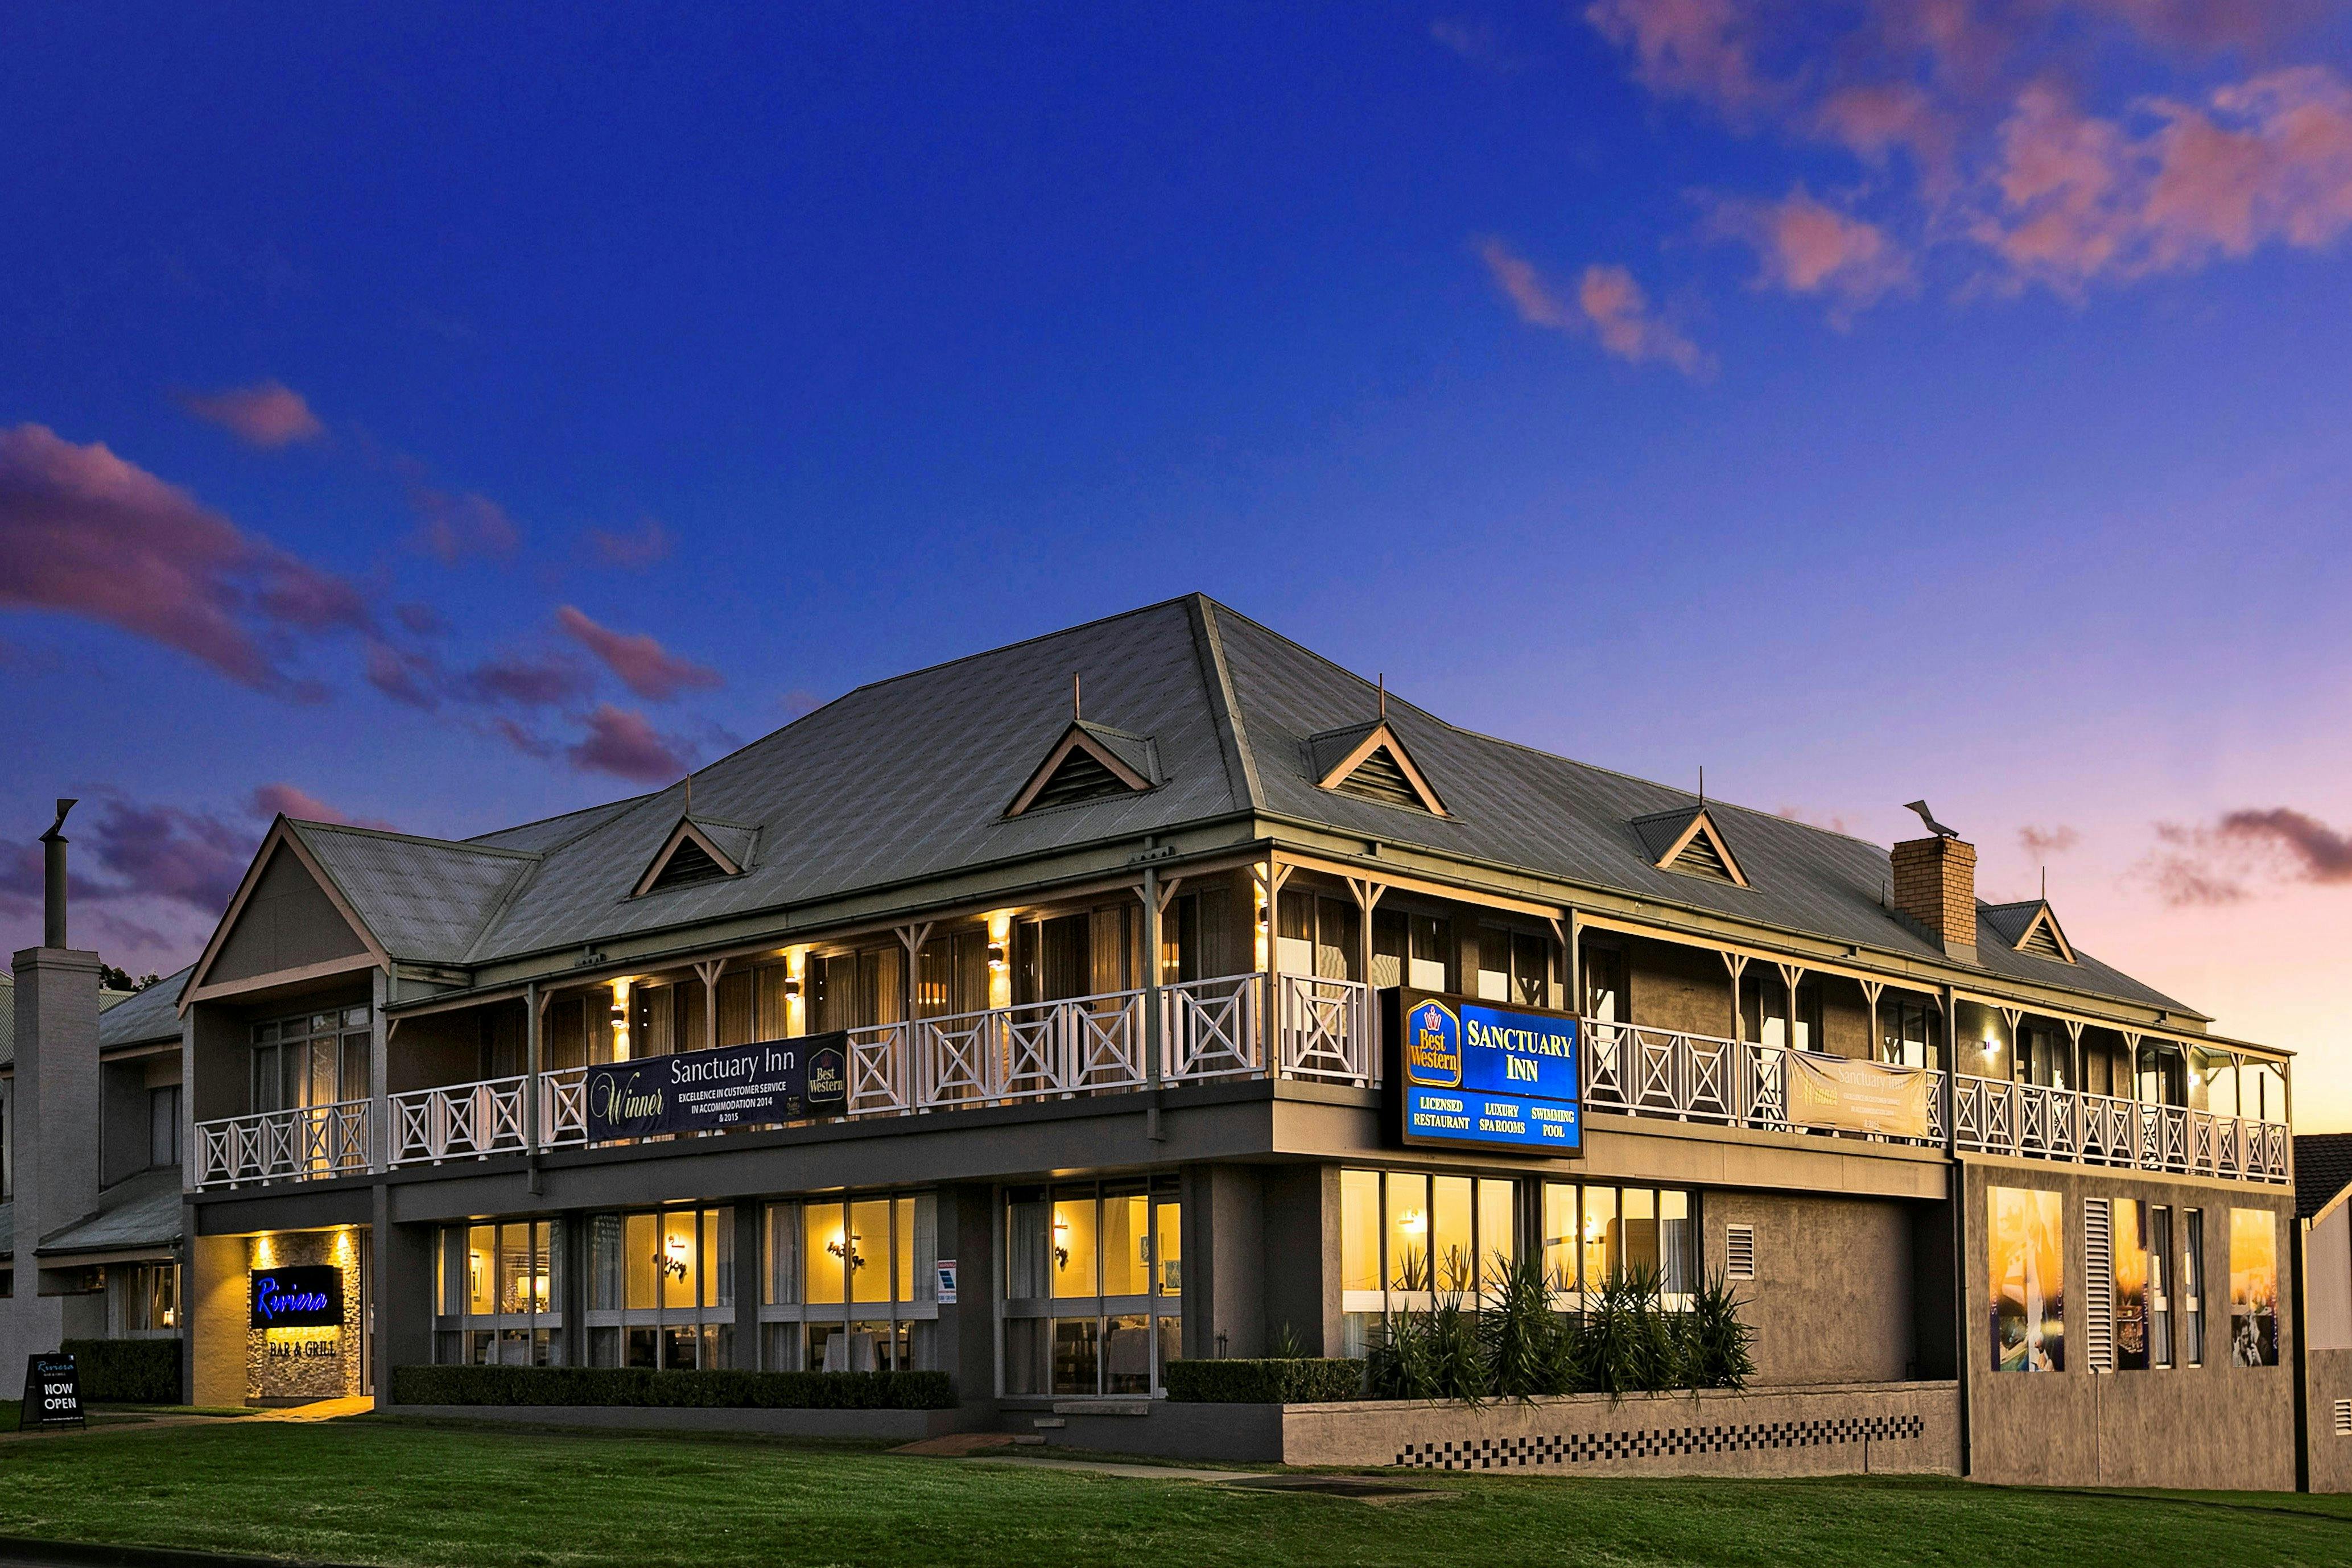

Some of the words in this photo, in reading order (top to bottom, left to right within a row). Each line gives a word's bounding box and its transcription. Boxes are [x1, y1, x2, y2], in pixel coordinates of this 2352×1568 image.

[1419, 1028, 1446, 1051] Best
[1468, 1020, 1573, 1058] SANCTUARY
[671, 1055, 758, 1084] Sanctuary
[765, 1048, 795, 1072] Inn
[1410, 1045, 1457, 1071] Western
[817, 1066, 835, 1081] Best
[1506, 1054, 1538, 1083] INN
[810, 1079, 843, 1093] Western
[1838, 1066, 1885, 1093] Sanctuary
[591, 1072, 664, 1125] Winner
[679, 1090, 716, 1103] EXCELLENCE
[716, 1089, 723, 1098] IN
[724, 1085, 760, 1097] CUSTOMER
[760, 1082, 786, 1093] SERVICE
[691, 1105, 699, 1114] IN
[699, 1099, 756, 1113] ACCOMMODATION
[757, 1096, 773, 1107] 2014
[1420, 1096, 1463, 1112] LICENSED
[1485, 1103, 1519, 1117] LUXURY
[719, 1114, 724, 1123] &
[724, 1112, 738, 1122] 2015
[1414, 1113, 1470, 1129] RESTAURANT
[1531, 1107, 1575, 1123] SWIMMING
[1479, 1119, 1494, 1132] SPA
[1495, 1120, 1525, 1134] ROOMS
[1542, 1124, 1565, 1138] POOL
[258, 1277, 327, 1319] Riviera
[270, 1342, 290, 1356] BAR
[294, 1342, 302, 1356] &
[305, 1340, 336, 1356] GRILL
[37, 1361, 74, 1372] Riviera
[44, 1383, 73, 1394] NOW
[44, 1398, 76, 1410] OPEN
